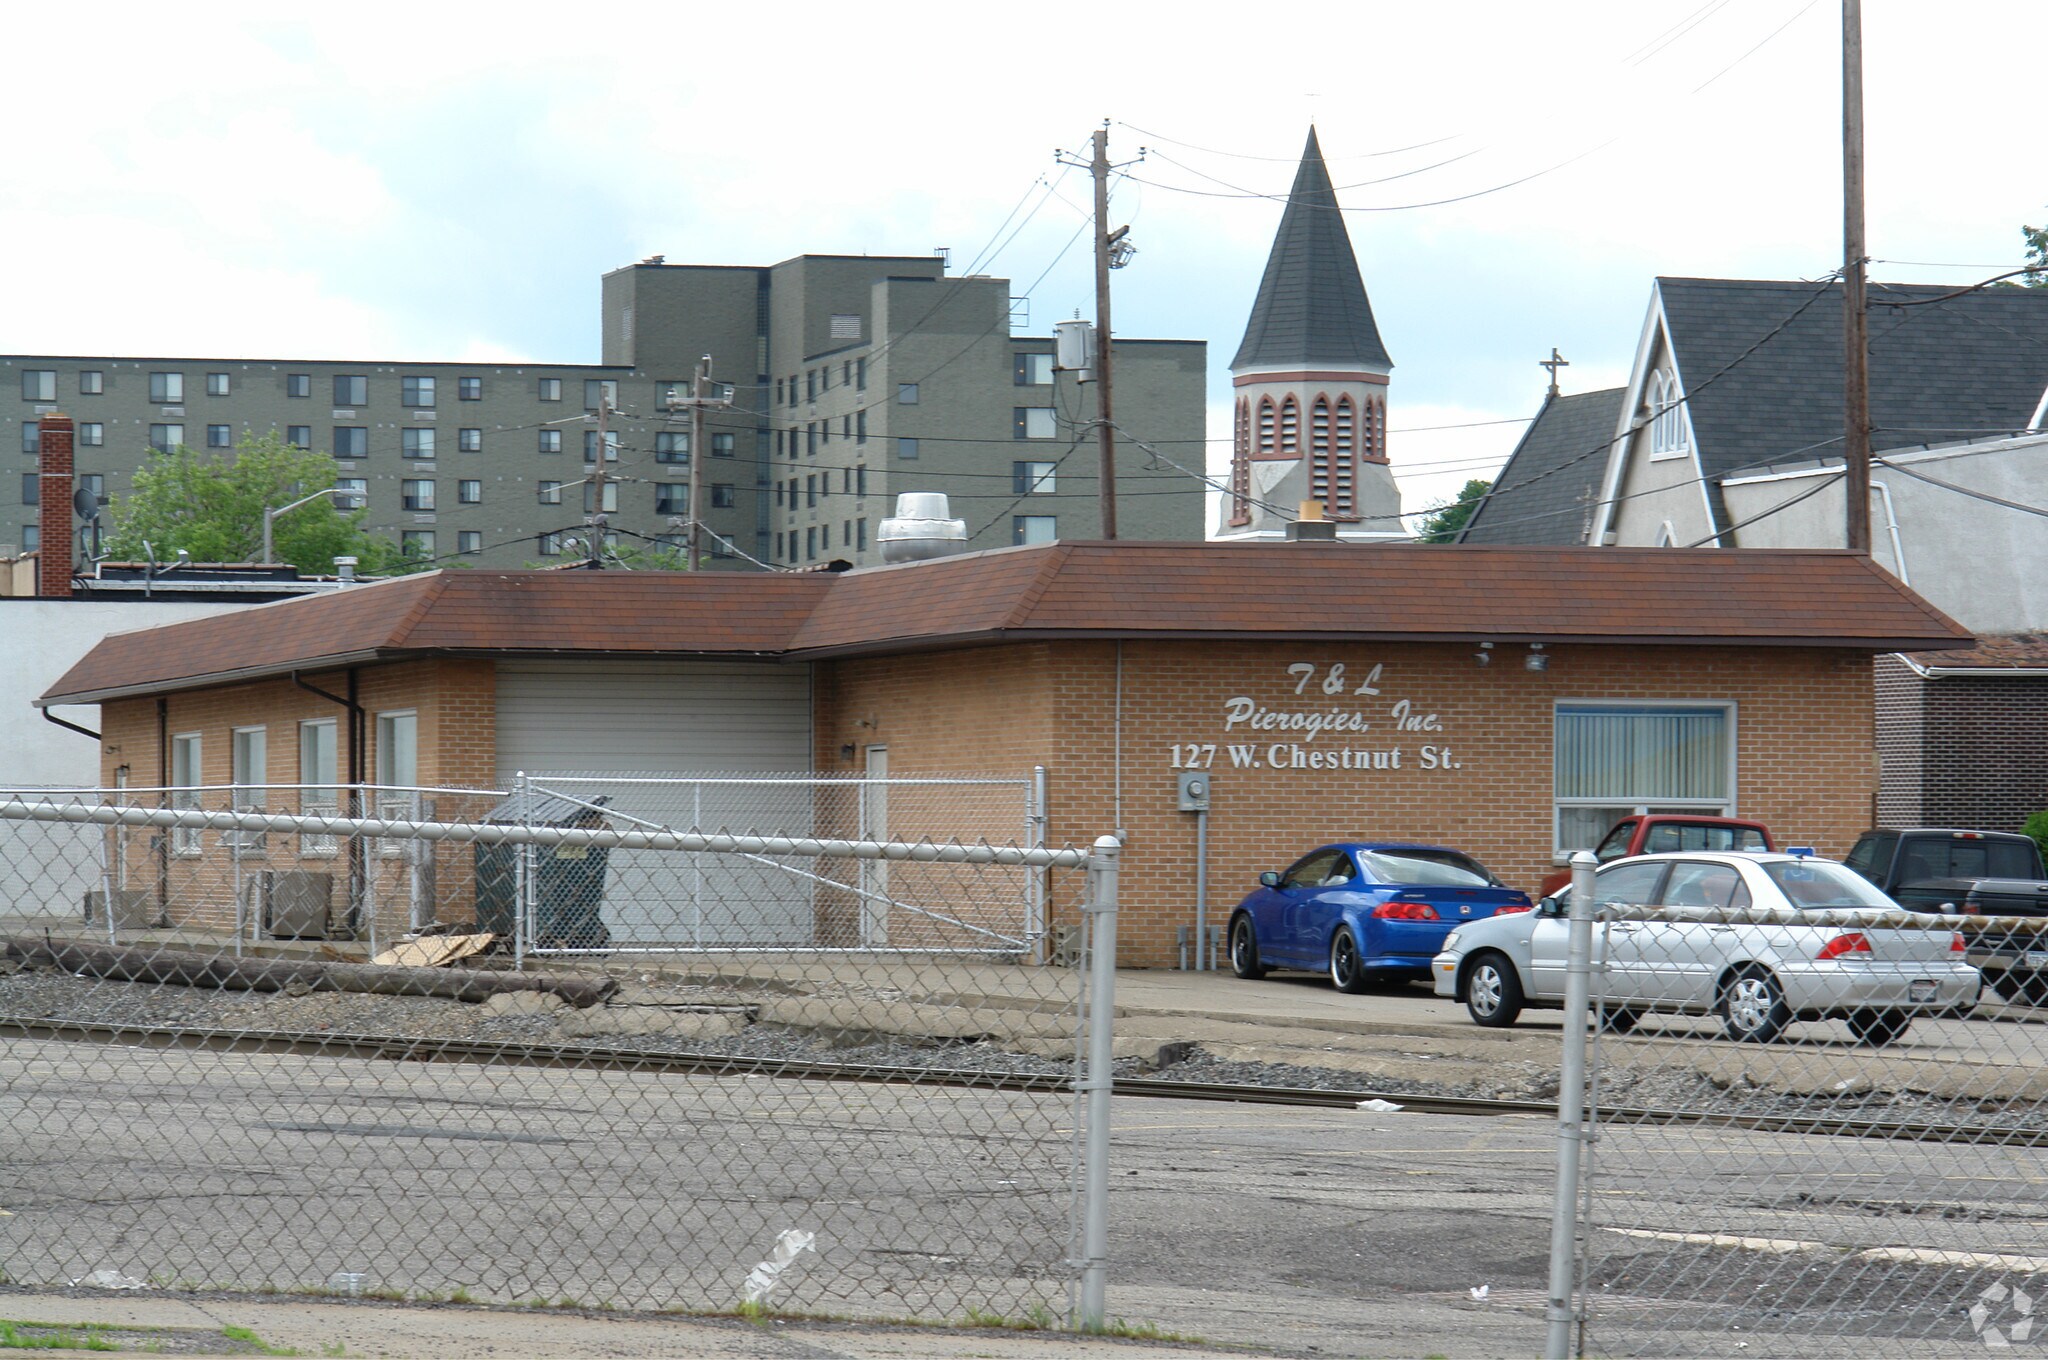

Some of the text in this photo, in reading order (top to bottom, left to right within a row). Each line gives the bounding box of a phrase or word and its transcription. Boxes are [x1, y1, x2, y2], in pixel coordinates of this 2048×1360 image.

[1322, 662, 1346, 695] &
[1354, 662, 1383, 696] L
[1224, 696, 1444, 743] Pierogies, Inc.
[1169, 744, 1462, 770] 127 W. Chestnut St.
